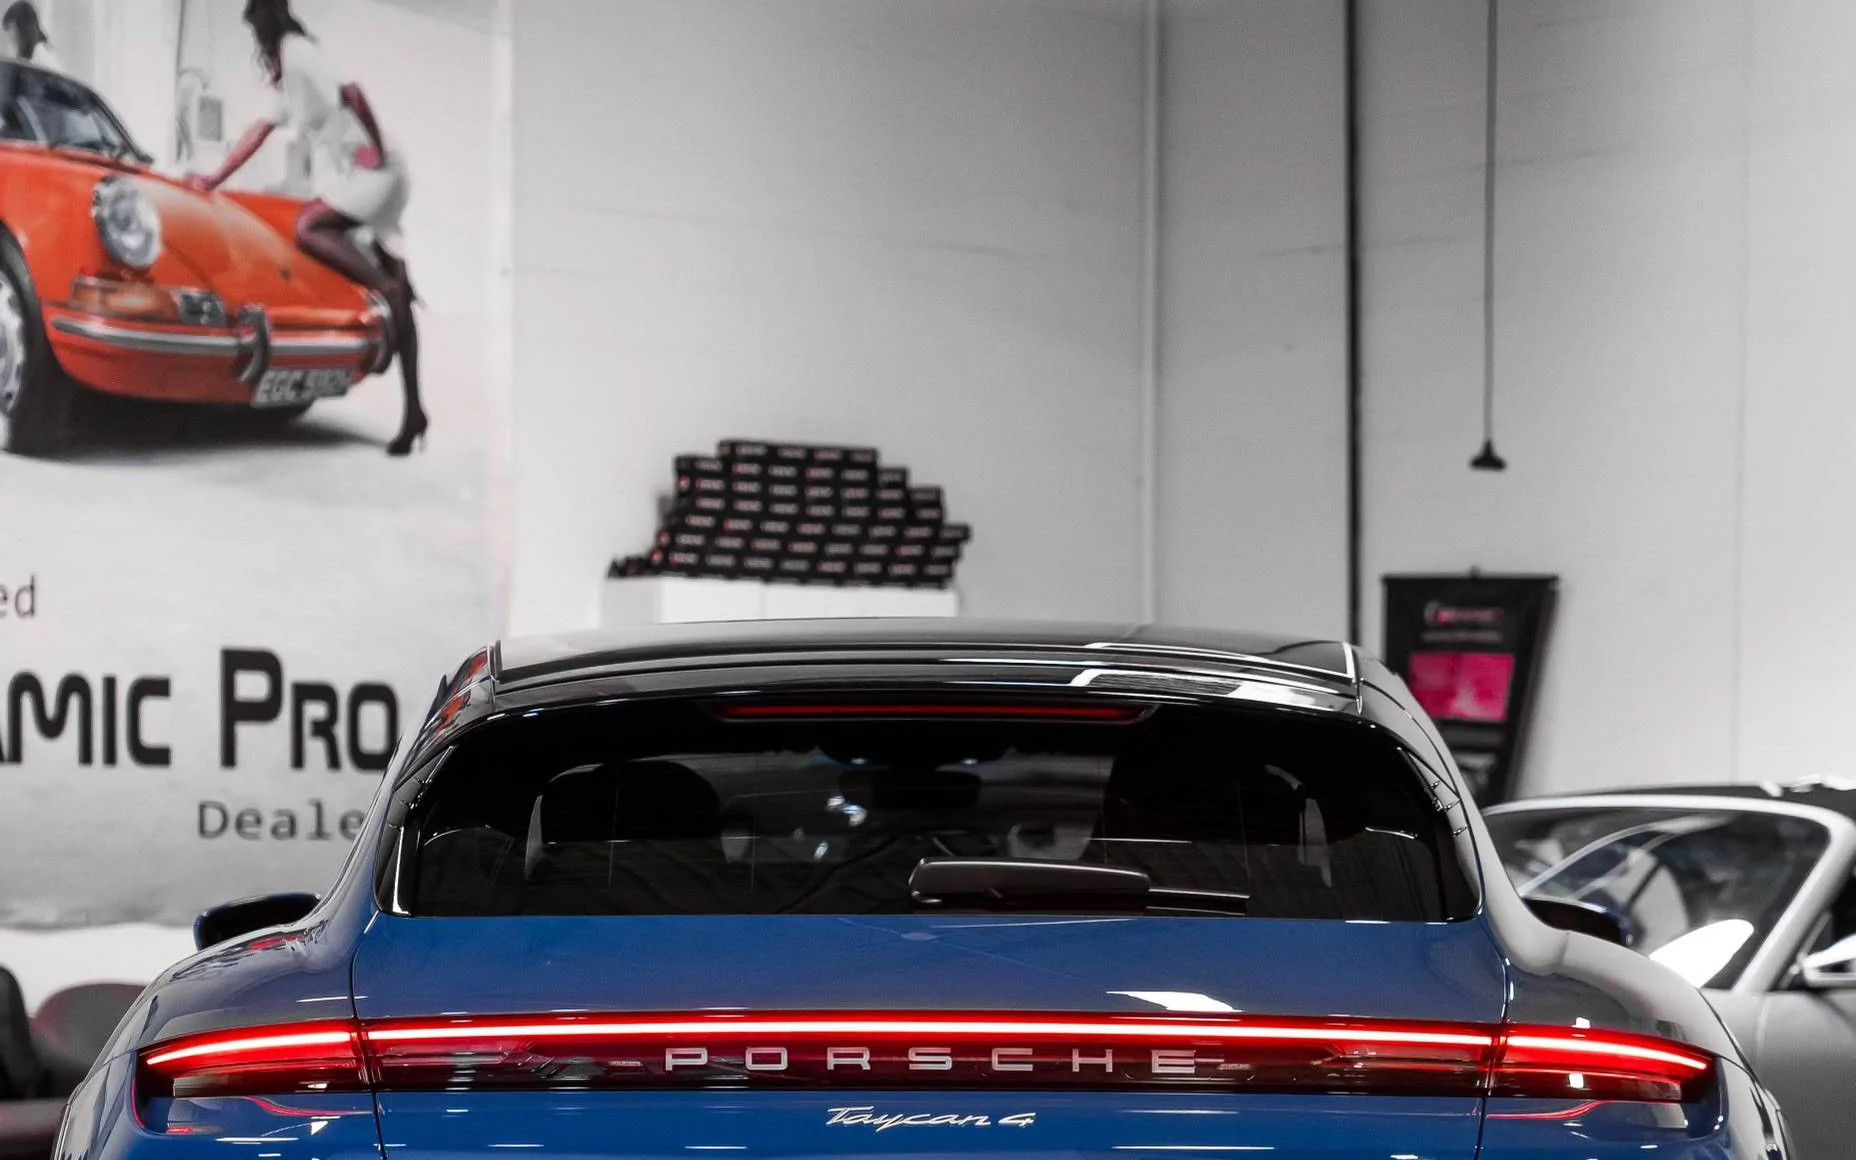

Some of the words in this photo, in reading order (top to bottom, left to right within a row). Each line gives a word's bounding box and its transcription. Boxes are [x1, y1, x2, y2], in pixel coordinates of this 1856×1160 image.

[0, 671, 172, 767] MIC
[665, 1047, 1196, 1074] PORSCHE
[826, 1105, 992, 1132] Taycan
[998, 1112, 1036, 1127] 4
